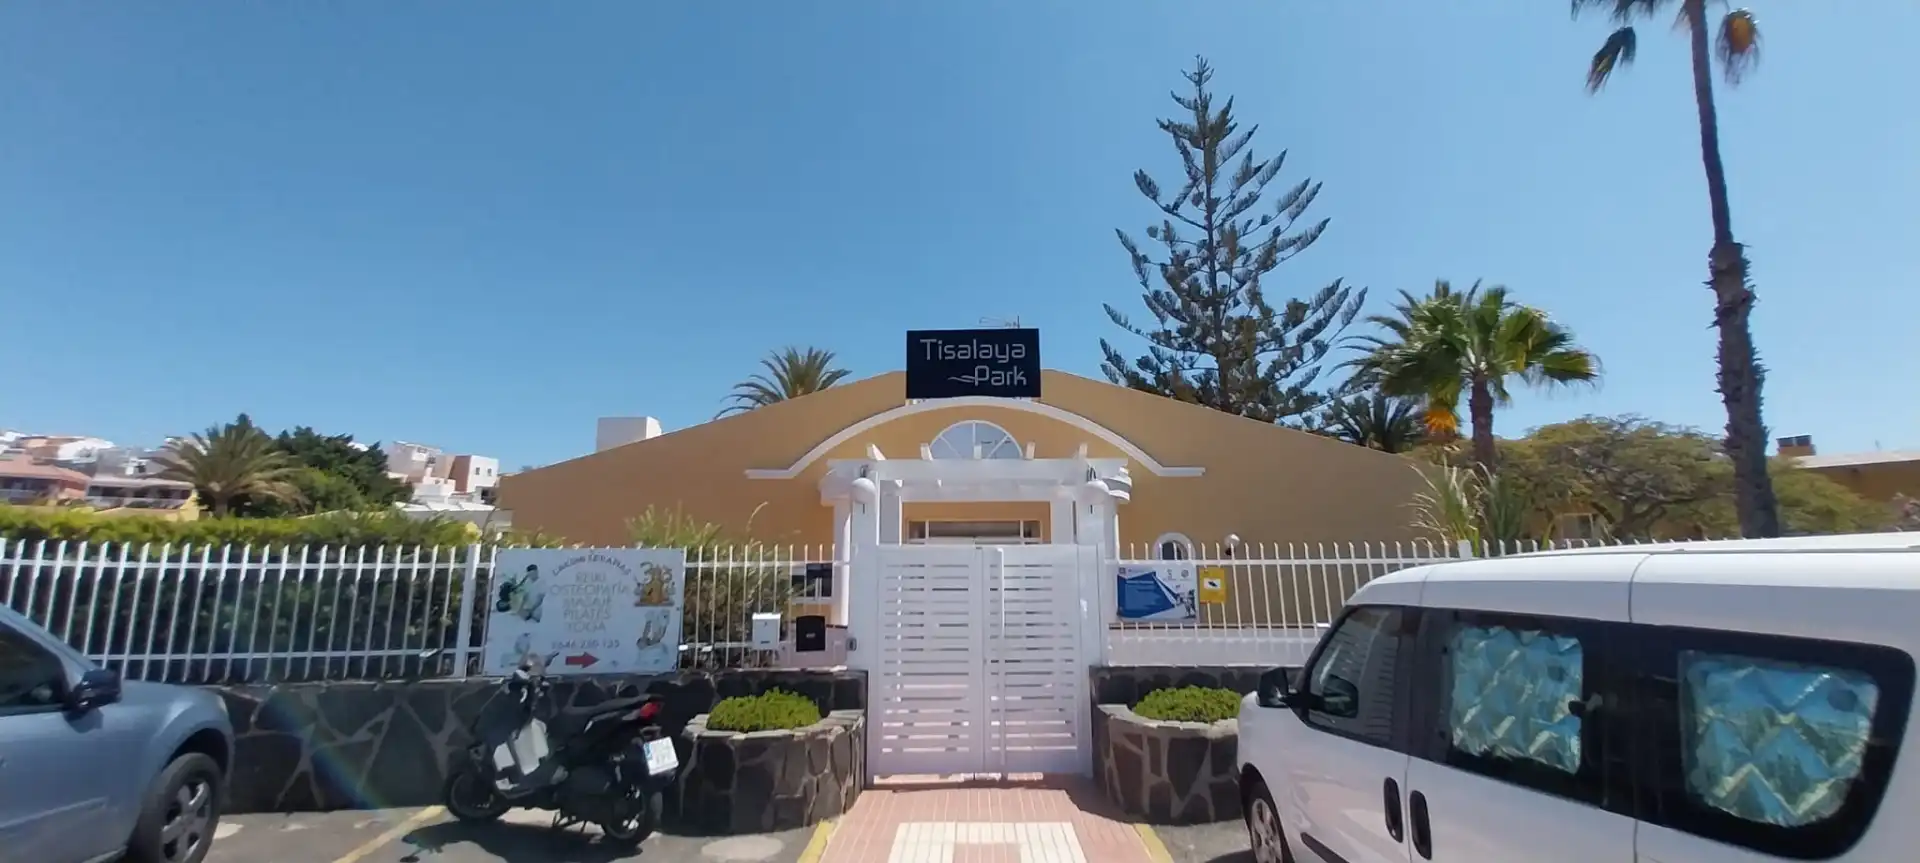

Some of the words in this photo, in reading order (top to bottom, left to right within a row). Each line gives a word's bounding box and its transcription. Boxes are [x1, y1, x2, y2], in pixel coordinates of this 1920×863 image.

[920, 338, 1026, 363] Tisalaya
[974, 365, 1027, 386] Park
[563, 608, 611, 620] PILATES
